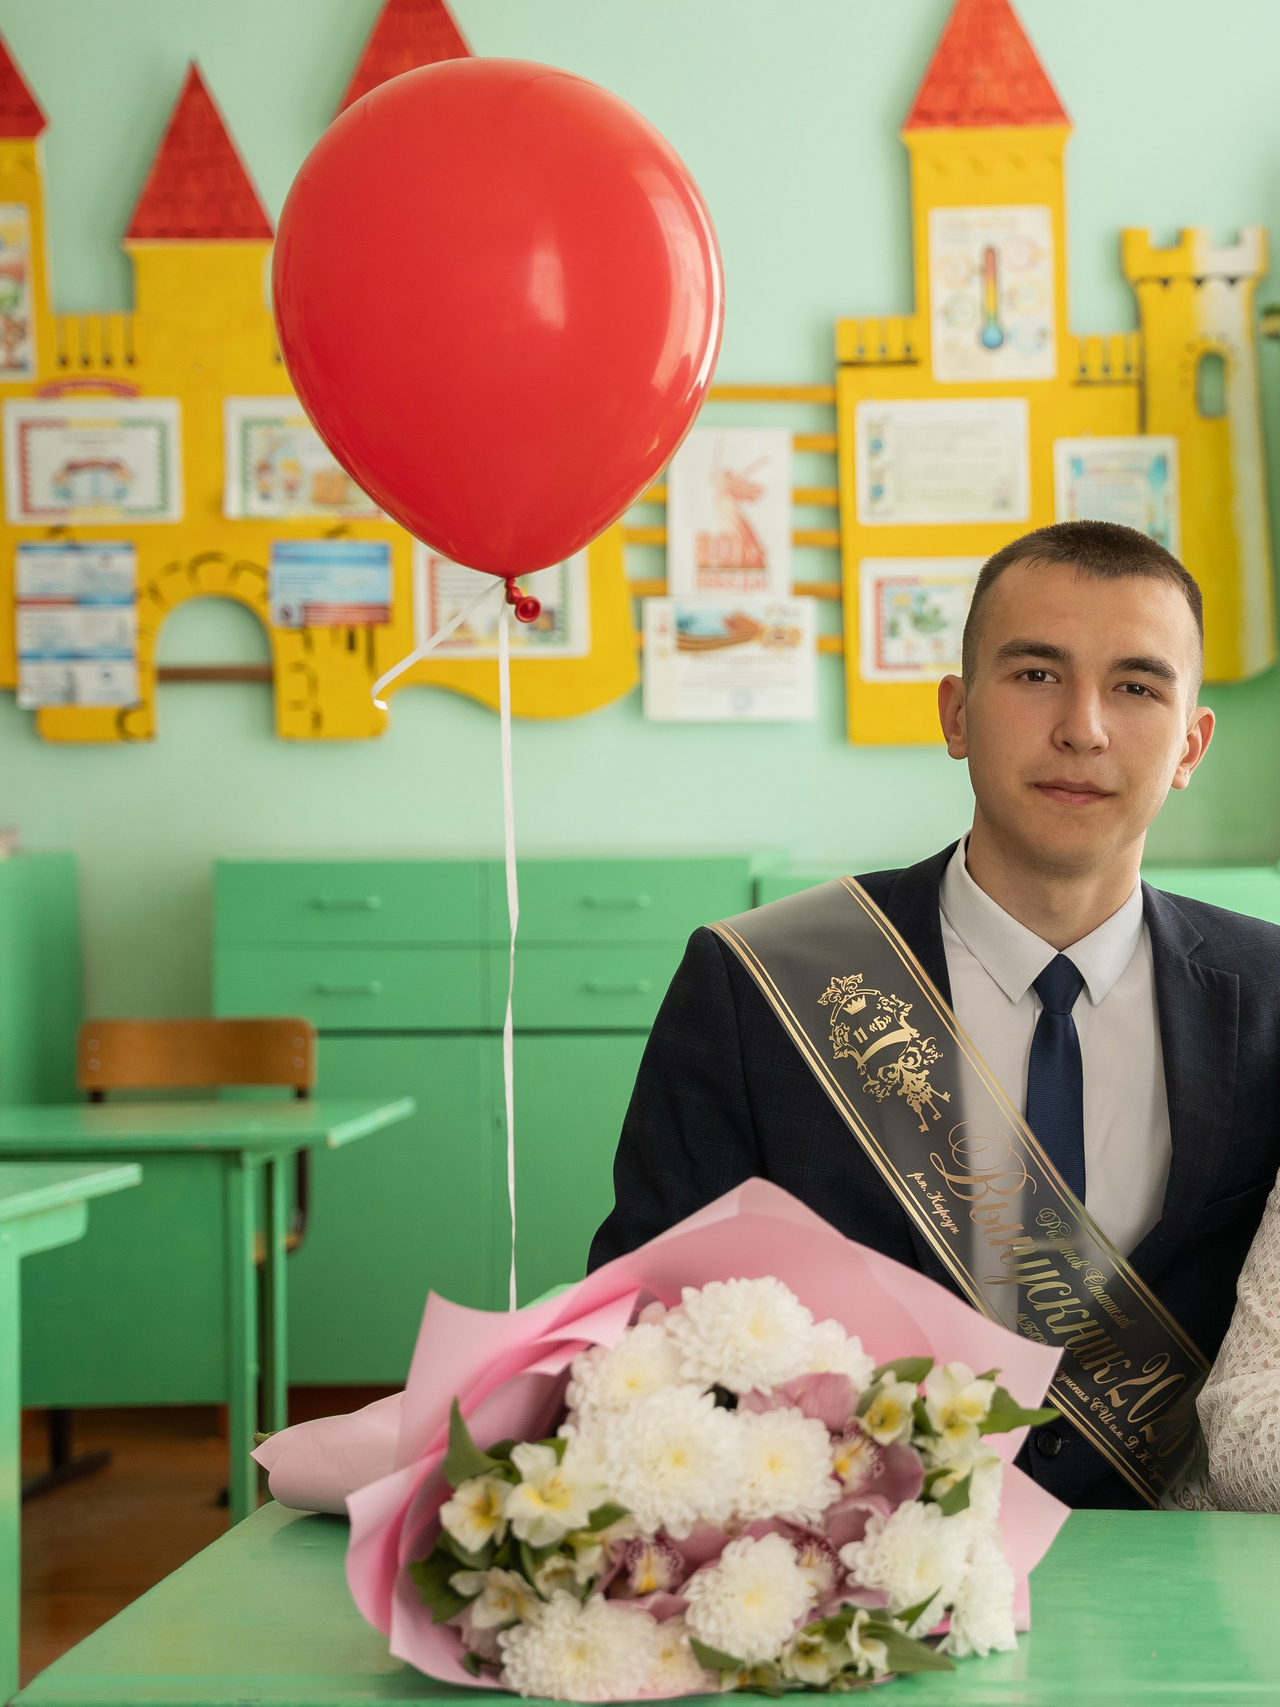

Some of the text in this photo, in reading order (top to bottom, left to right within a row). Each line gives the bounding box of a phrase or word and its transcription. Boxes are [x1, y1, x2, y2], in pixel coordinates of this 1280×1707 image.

[853, 1015, 892, 1044] 11 «Б»
[930, 1120, 1131, 1385] Выпускник
[1035, 1207, 1138, 1331] Романов Станислав
[1089, 1396, 1112, 1426] СШ
